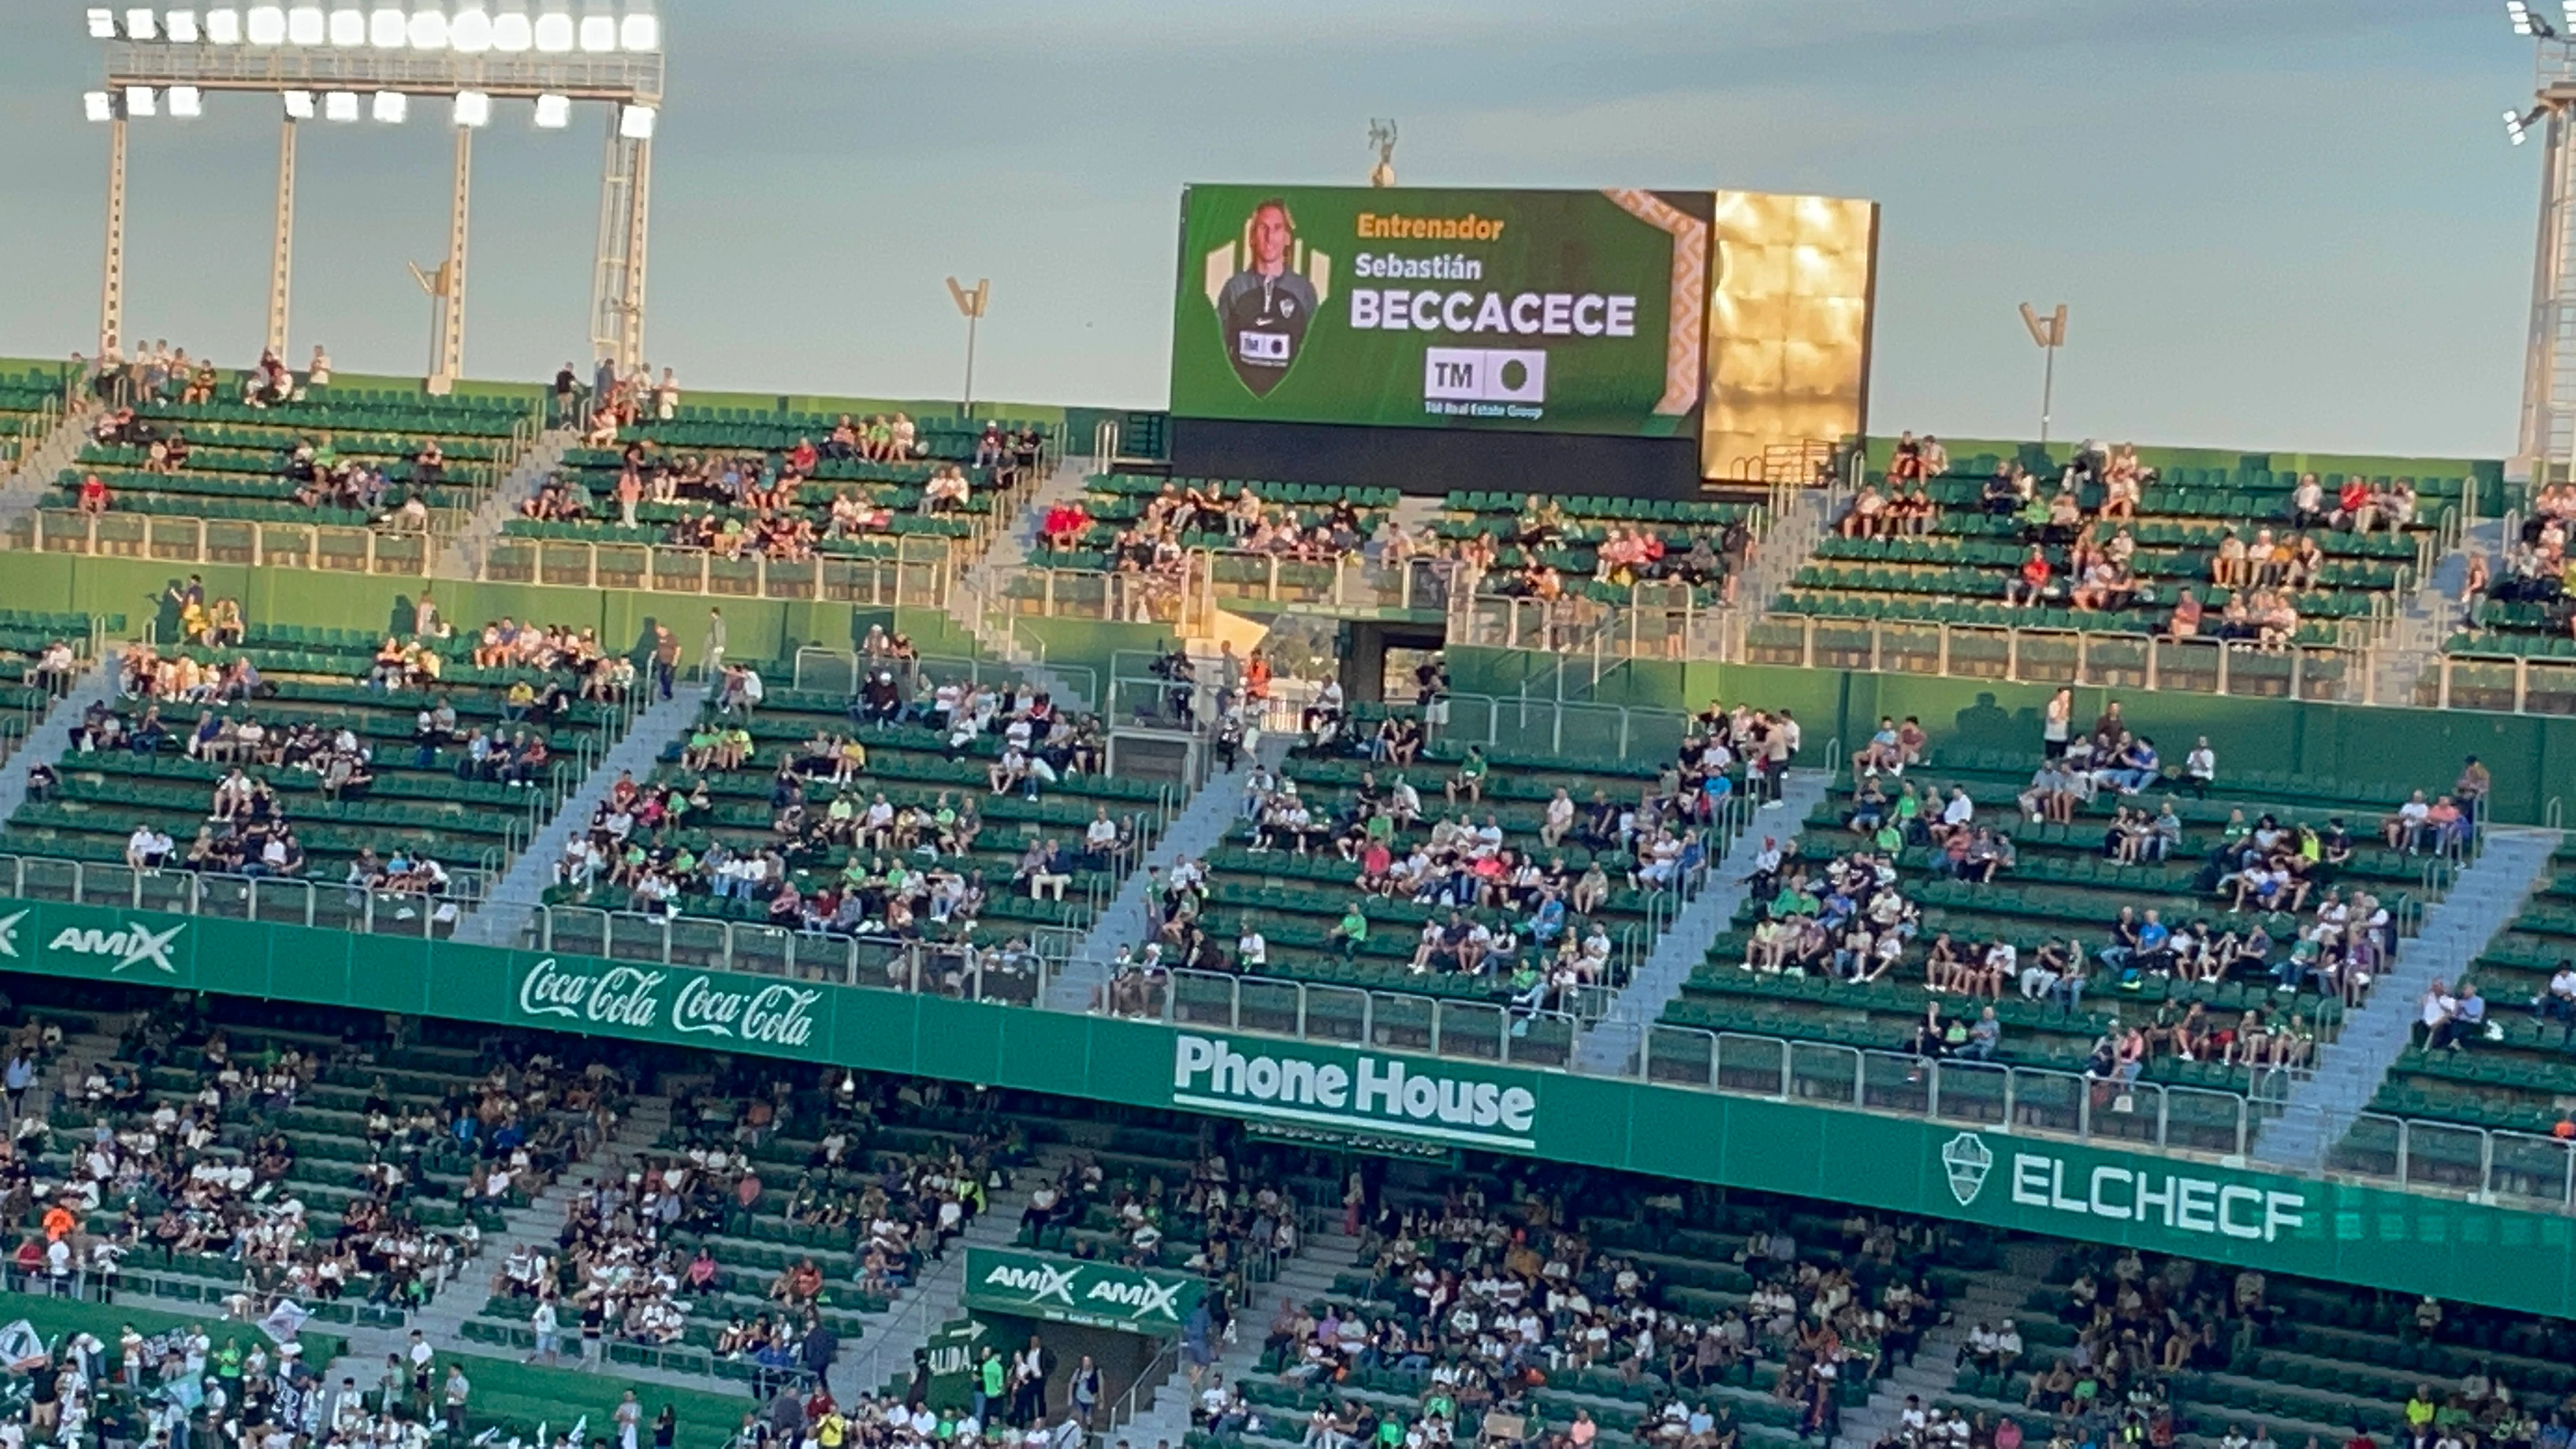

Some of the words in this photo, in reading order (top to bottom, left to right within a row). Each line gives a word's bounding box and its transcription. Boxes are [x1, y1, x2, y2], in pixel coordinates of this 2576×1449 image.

[1357, 213, 1505, 242] Entrenador
[1355, 252, 1483, 280] Sebastián
[1350, 288, 1637, 337] BECCACECE
[1434, 362, 1473, 389] TM
[48, 921, 187, 973] AMIX
[1174, 1033, 1349, 1108] Phone
[1355, 1056, 1536, 1131] House
[985, 1263, 1084, 1306] AMIX
[1087, 1277, 1186, 1320] AMIX
[927, 1344, 972, 1376] ALIDA
